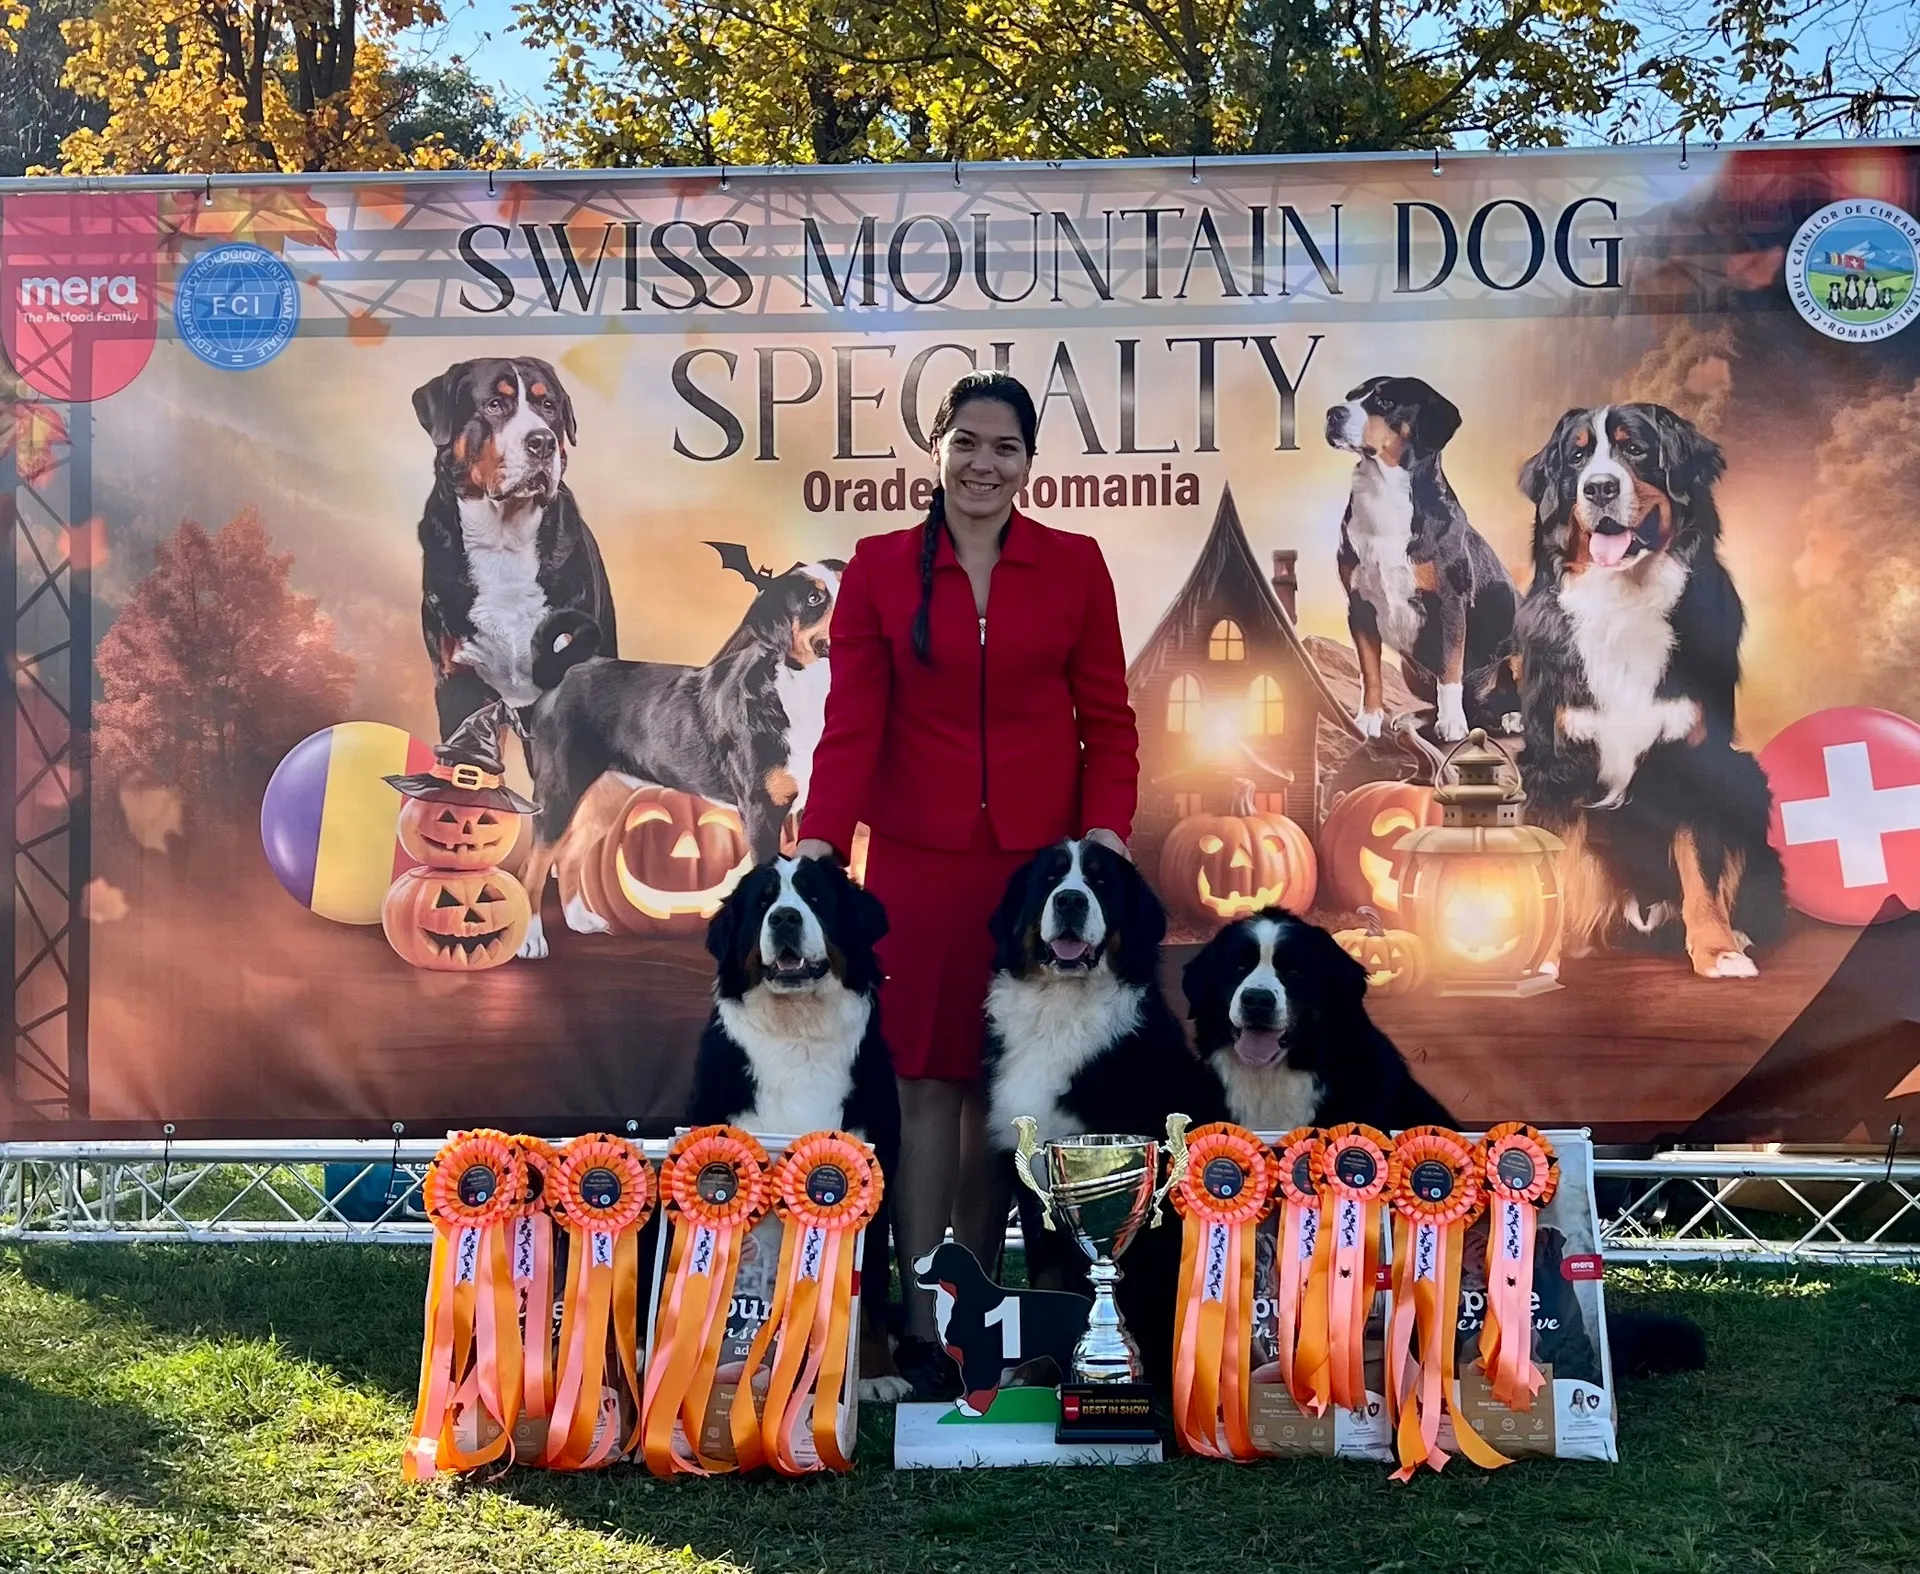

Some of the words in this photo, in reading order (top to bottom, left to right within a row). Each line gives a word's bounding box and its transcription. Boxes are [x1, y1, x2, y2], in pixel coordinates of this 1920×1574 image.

[186, 249, 269, 288] CYNOLOGIQUE
[457, 219, 755, 313] SWISS
[800, 203, 1343, 308] MOUNTAIN
[1392, 196, 1624, 293] DOG
[1792, 272, 1822, 322] CLUBUL
[1844, 204, 1863, 215] DE
[21, 275, 139, 306] mera
[212, 295, 260, 316] FCI
[255, 262, 294, 359] INTERNATIONALE
[23, 311, 44, 323] The
[46, 311, 94, 323] Petfood
[96, 311, 139, 324] Family
[181, 289, 220, 359] FEDERATION
[802, 467, 934, 513] Orade
[1570, 1261, 1595, 1270] mera
[984, 1296, 1022, 1359] 1
[1082, 1405, 1107, 1415] BEST
[1108, 1405, 1119, 1414] IN
[1120, 1405, 1150, 1415] SHOW
